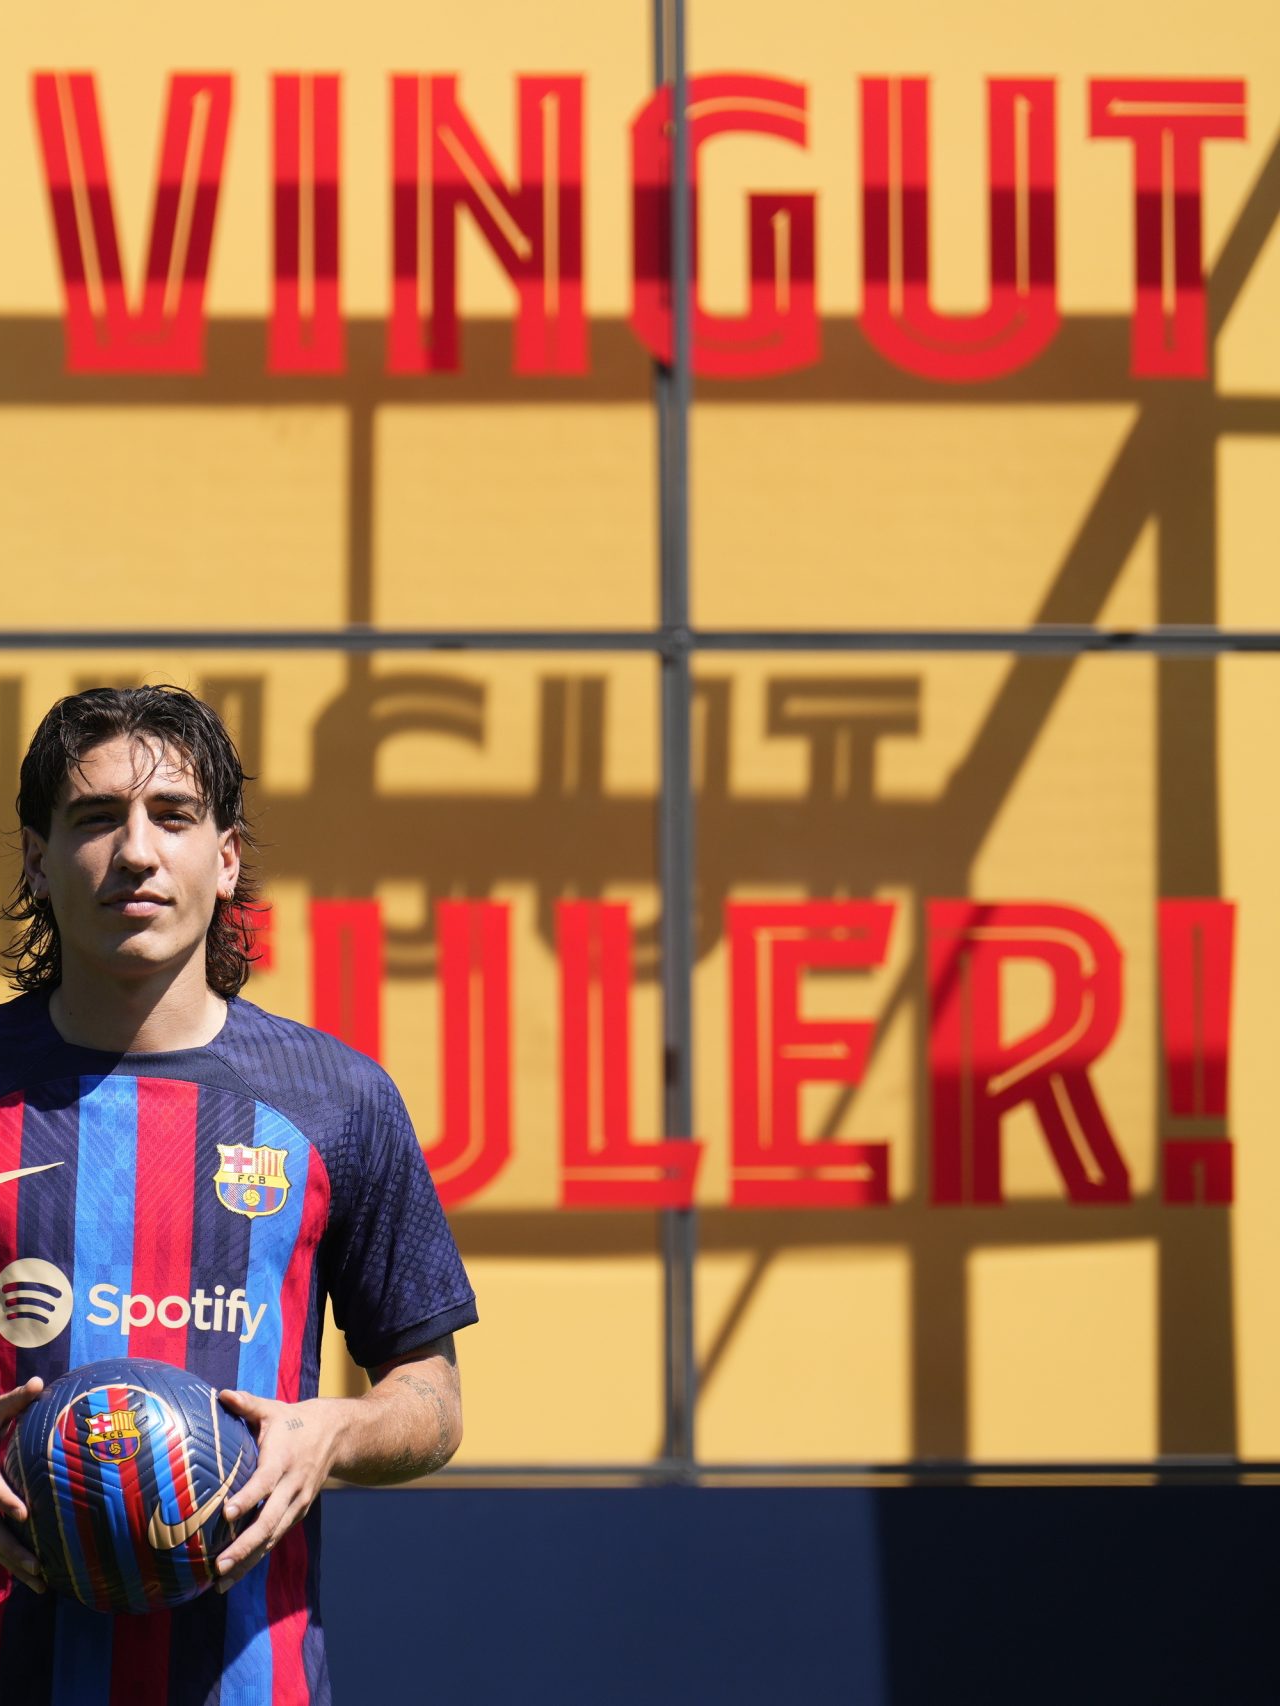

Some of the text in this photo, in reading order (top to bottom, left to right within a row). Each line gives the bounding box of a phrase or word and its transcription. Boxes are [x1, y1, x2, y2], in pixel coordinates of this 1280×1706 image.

[30, 70, 1248, 382] VINGUT
[232, 898, 1236, 1208] ULER!
[86, 1283, 268, 1344] Spotify
